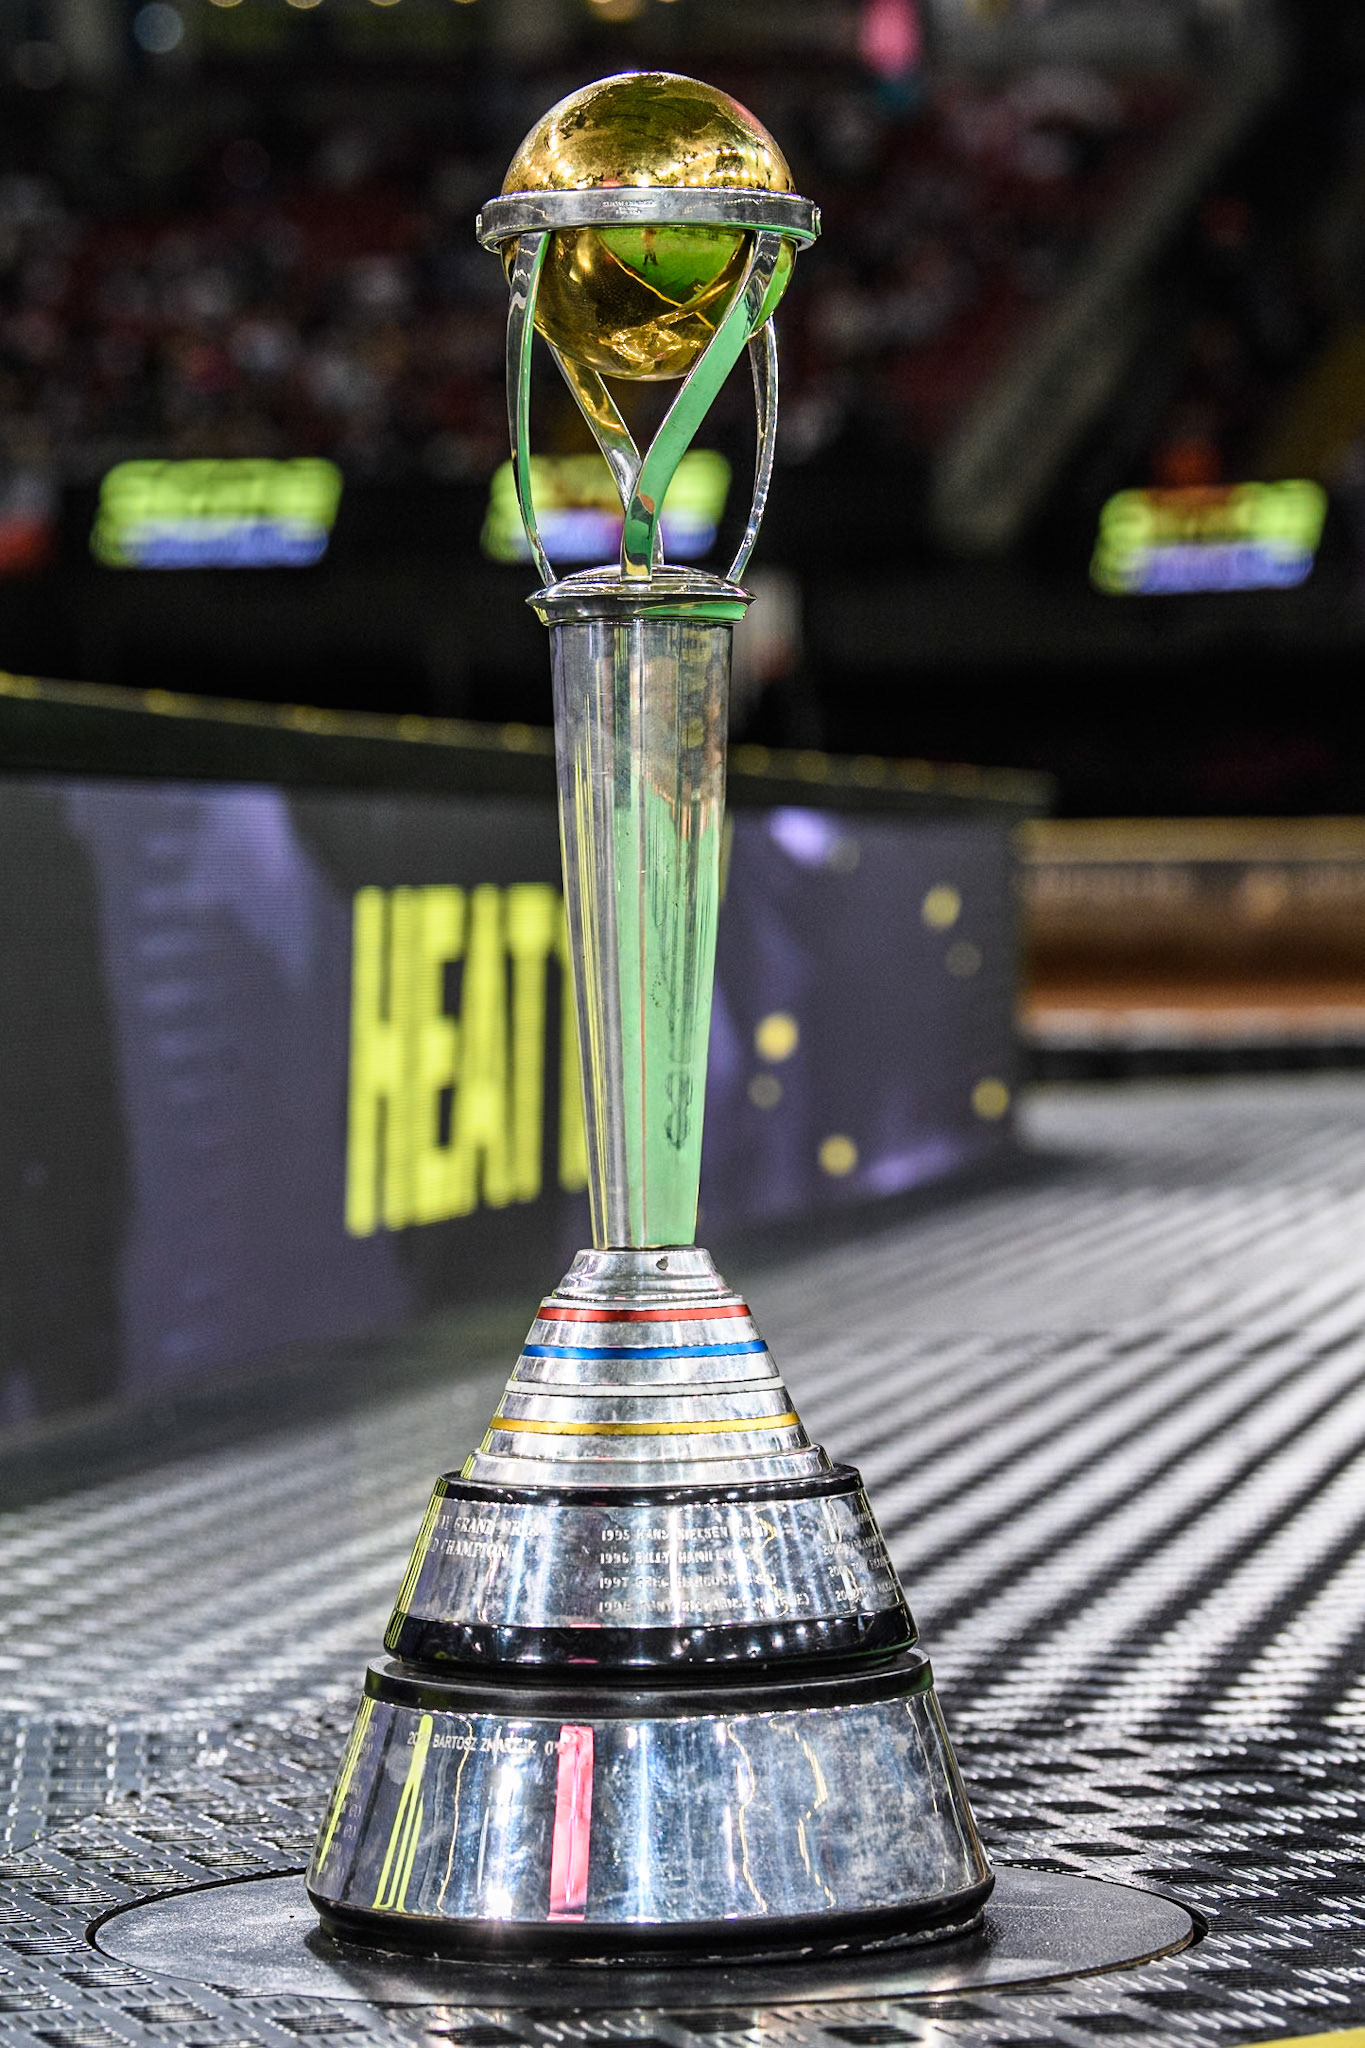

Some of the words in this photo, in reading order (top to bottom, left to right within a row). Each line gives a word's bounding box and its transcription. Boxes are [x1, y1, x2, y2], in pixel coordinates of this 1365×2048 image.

[454, 1517, 495, 1536] GRAND
[601, 1530, 630, 1541] 1995
[441, 1540, 508, 1559] CHAMPION
[600, 1552, 630, 1564] 1996
[599, 1576, 629, 1589] 1997
[432, 1735, 476, 1751] BARTOSZ
